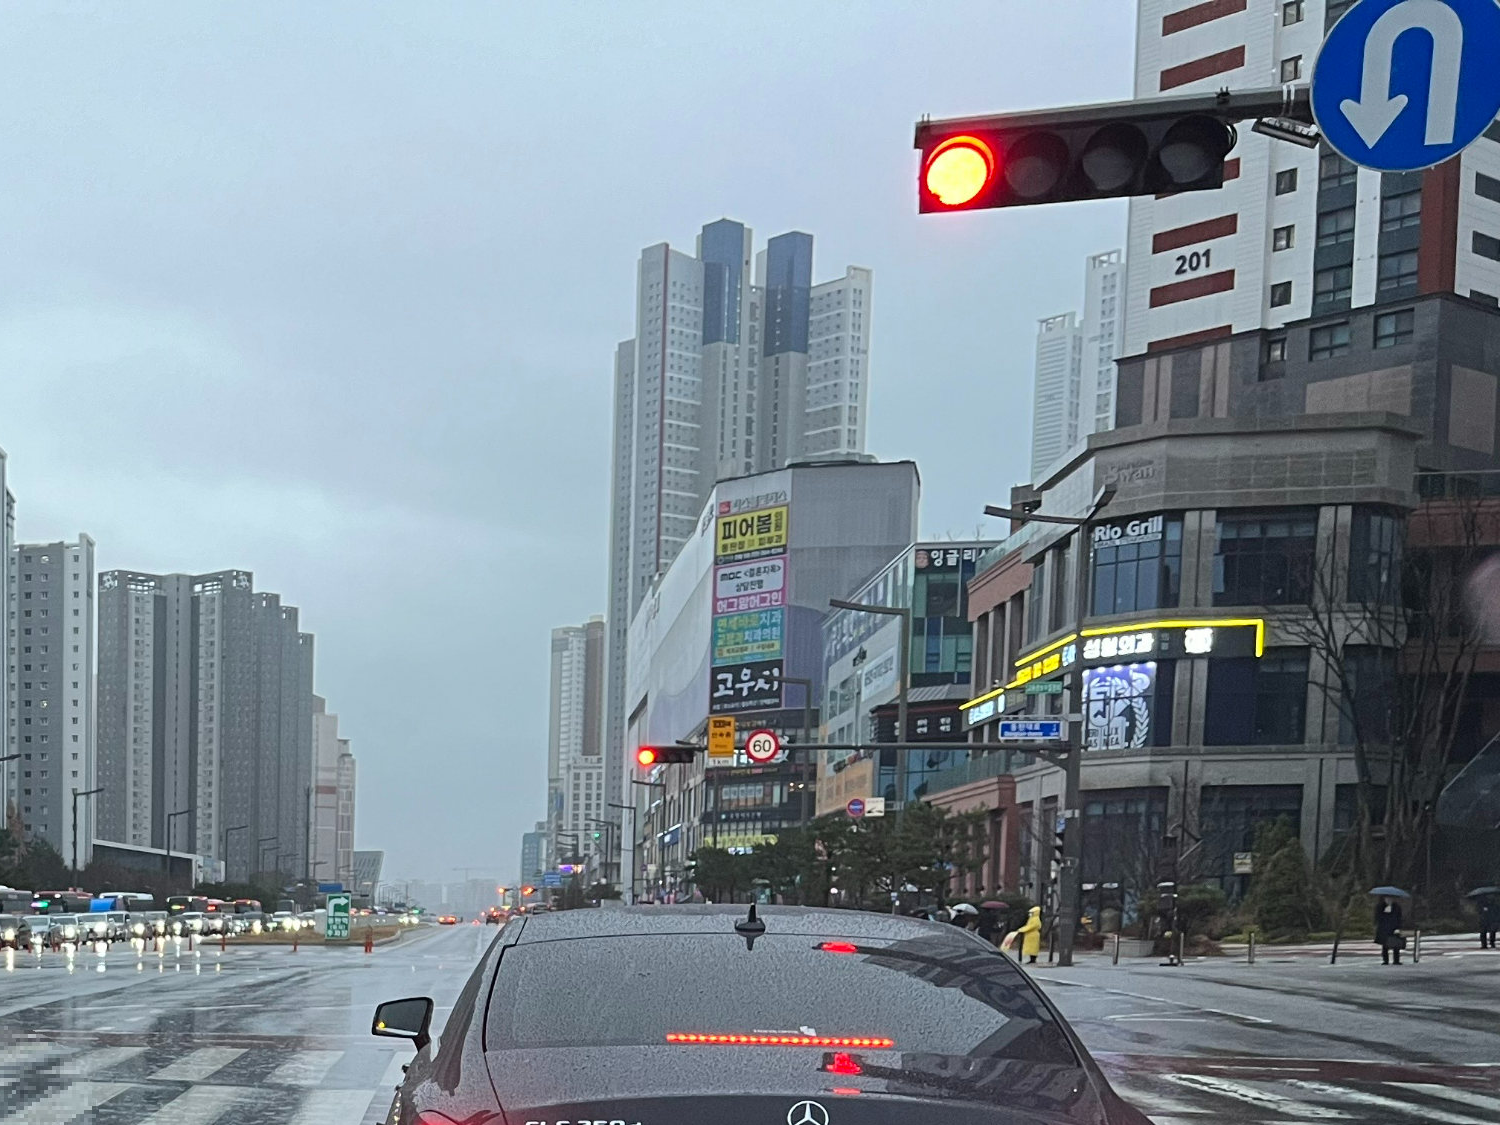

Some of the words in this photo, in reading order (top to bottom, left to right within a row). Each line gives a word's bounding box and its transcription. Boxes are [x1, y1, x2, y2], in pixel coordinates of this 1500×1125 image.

[1175, 248, 1211, 276] 201
[721, 513, 772, 540] 피어봄
[1094, 523, 1122, 542] Rio
[1126, 514, 1163, 537] Grill
[753, 740, 772, 753] 60
